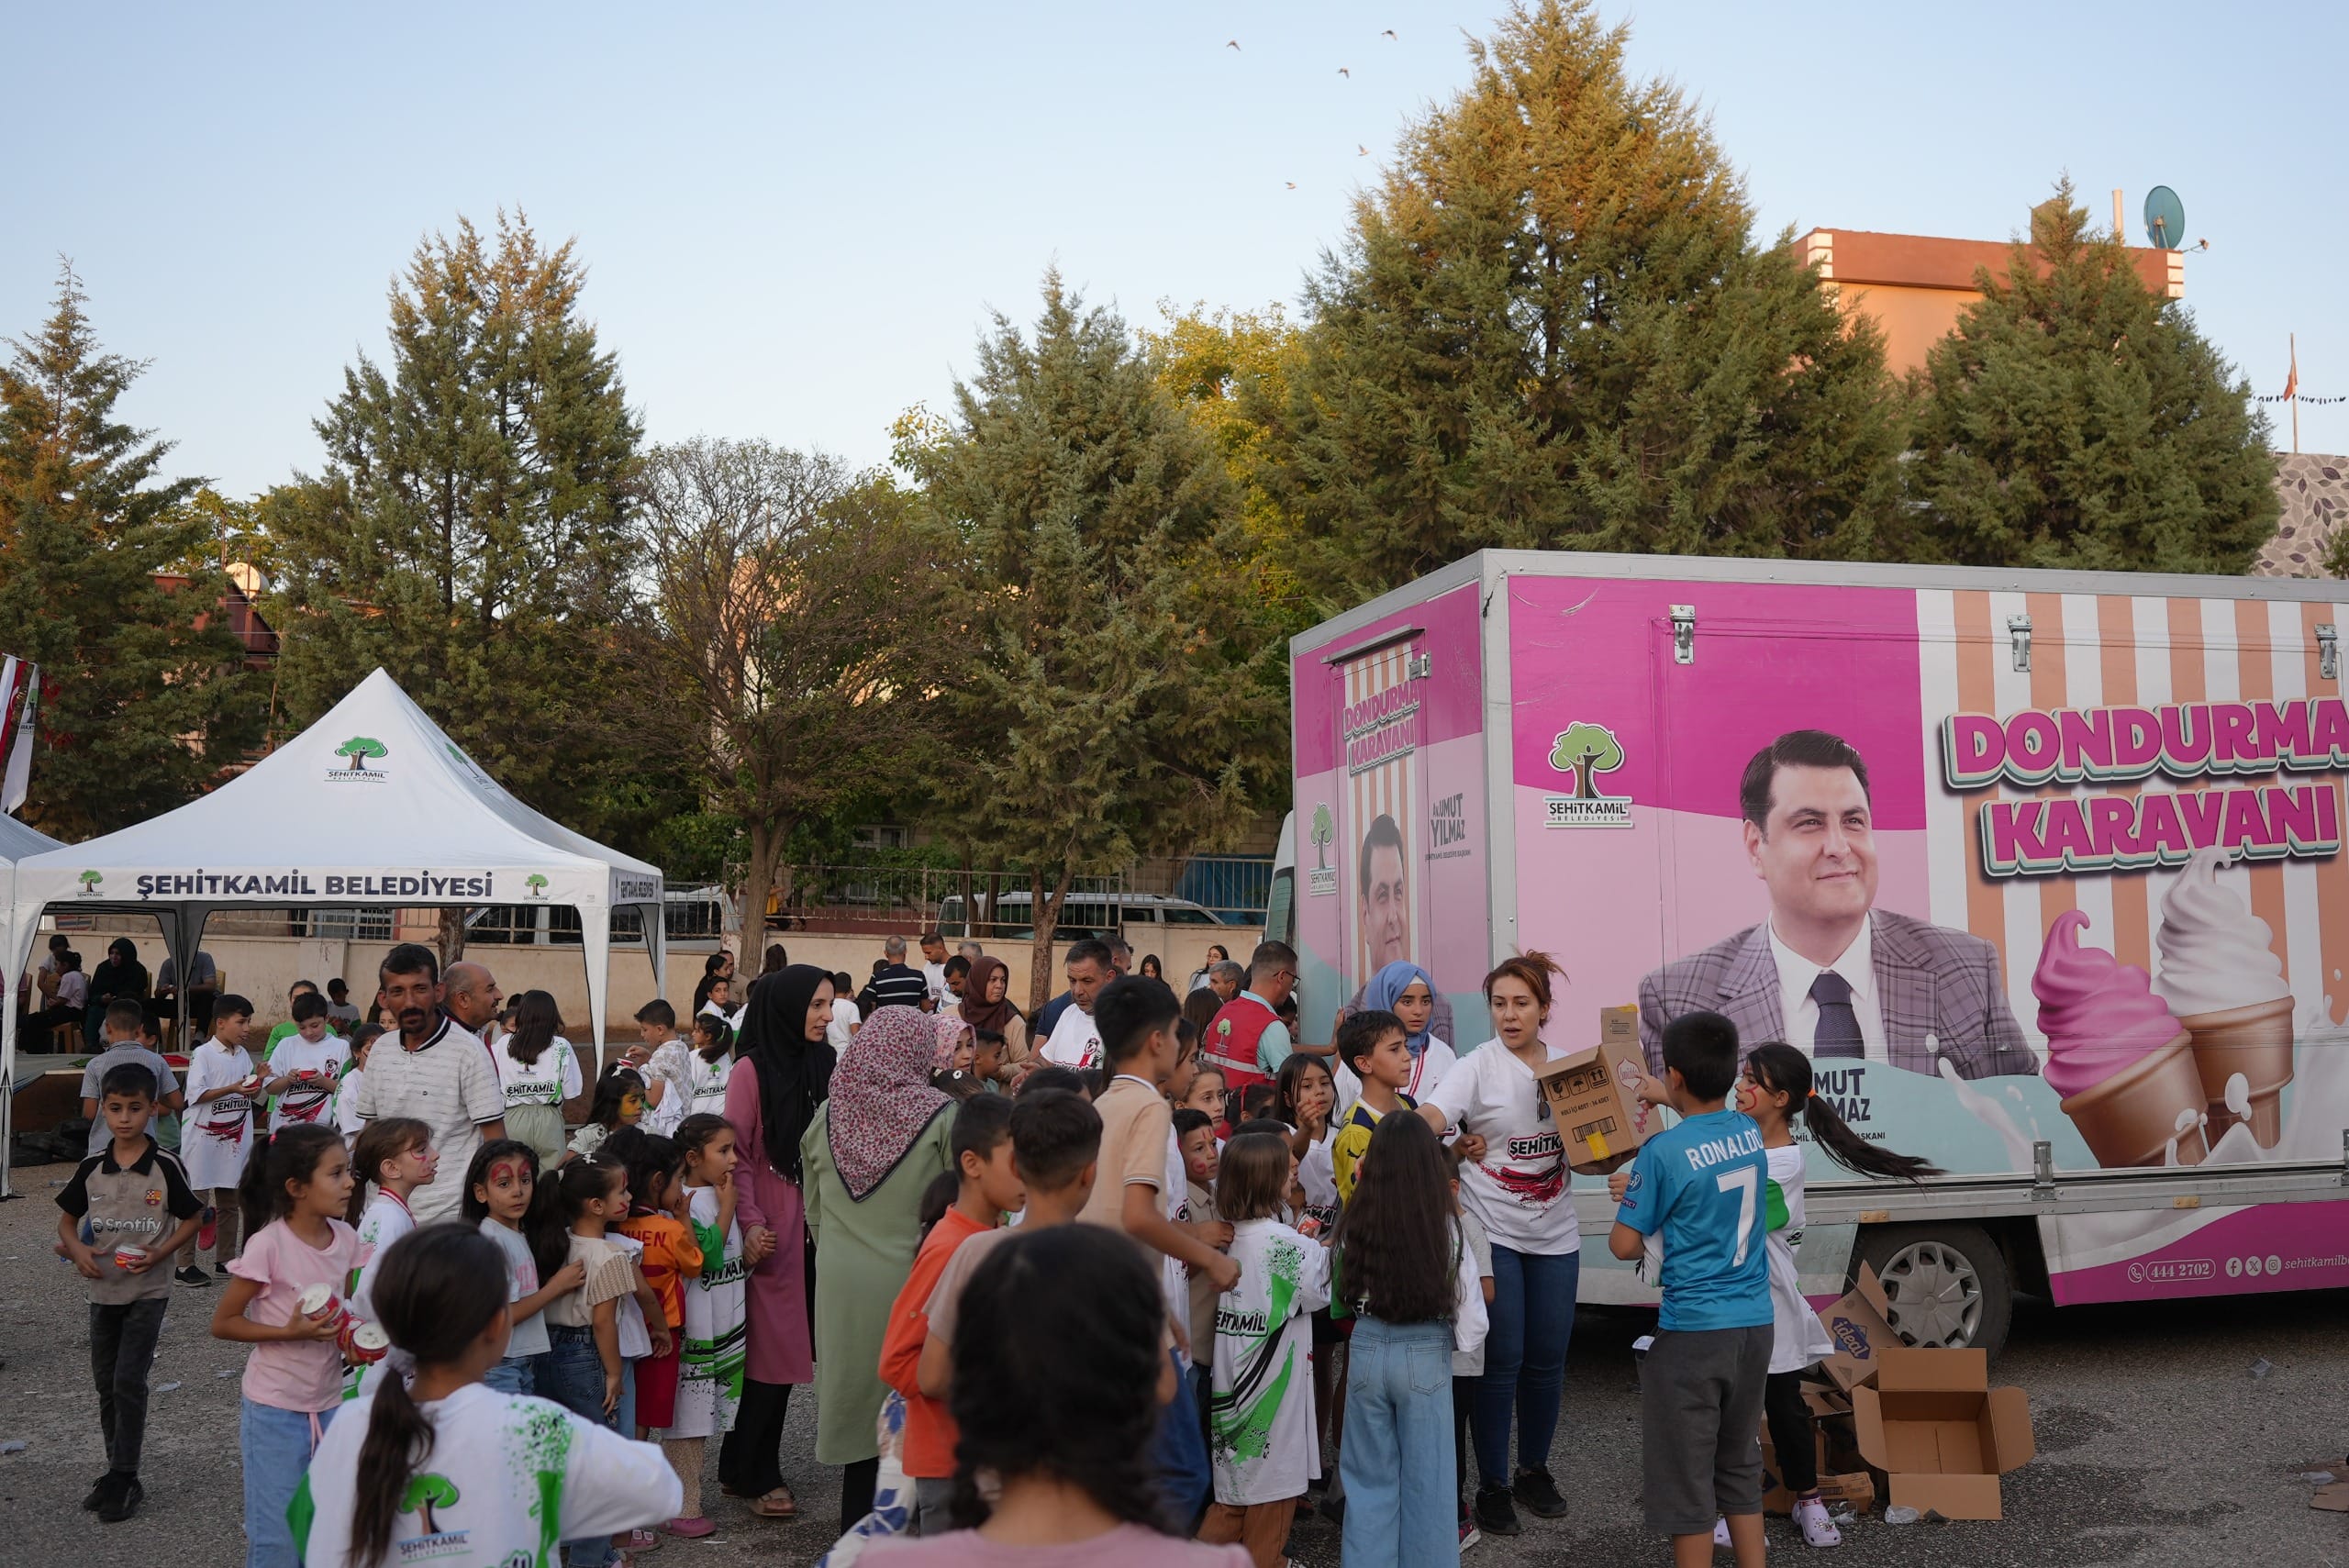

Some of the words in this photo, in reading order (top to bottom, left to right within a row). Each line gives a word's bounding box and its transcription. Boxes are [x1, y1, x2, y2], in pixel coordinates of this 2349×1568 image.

[1344, 679, 1420, 738] DONDURMA
[1350, 717, 1416, 771] KARAVANI
[1946, 698, 2349, 784] DONDURMA
[1431, 819, 1465, 848] YILMAZ
[1986, 784, 2341, 872] KARAVANI
[137, 869, 316, 900] ŞEHİTKAMİL
[325, 870, 492, 896] BELEDİYESİ
[1813, 1068, 1865, 1095] MUT
[106, 1217, 162, 1234] Spotify
[1716, 1163, 1758, 1267] 7
[2150, 1264, 2176, 1278] 444
[2178, 1262, 2210, 1277] 2702
[1834, 1320, 1870, 1357] ideal
